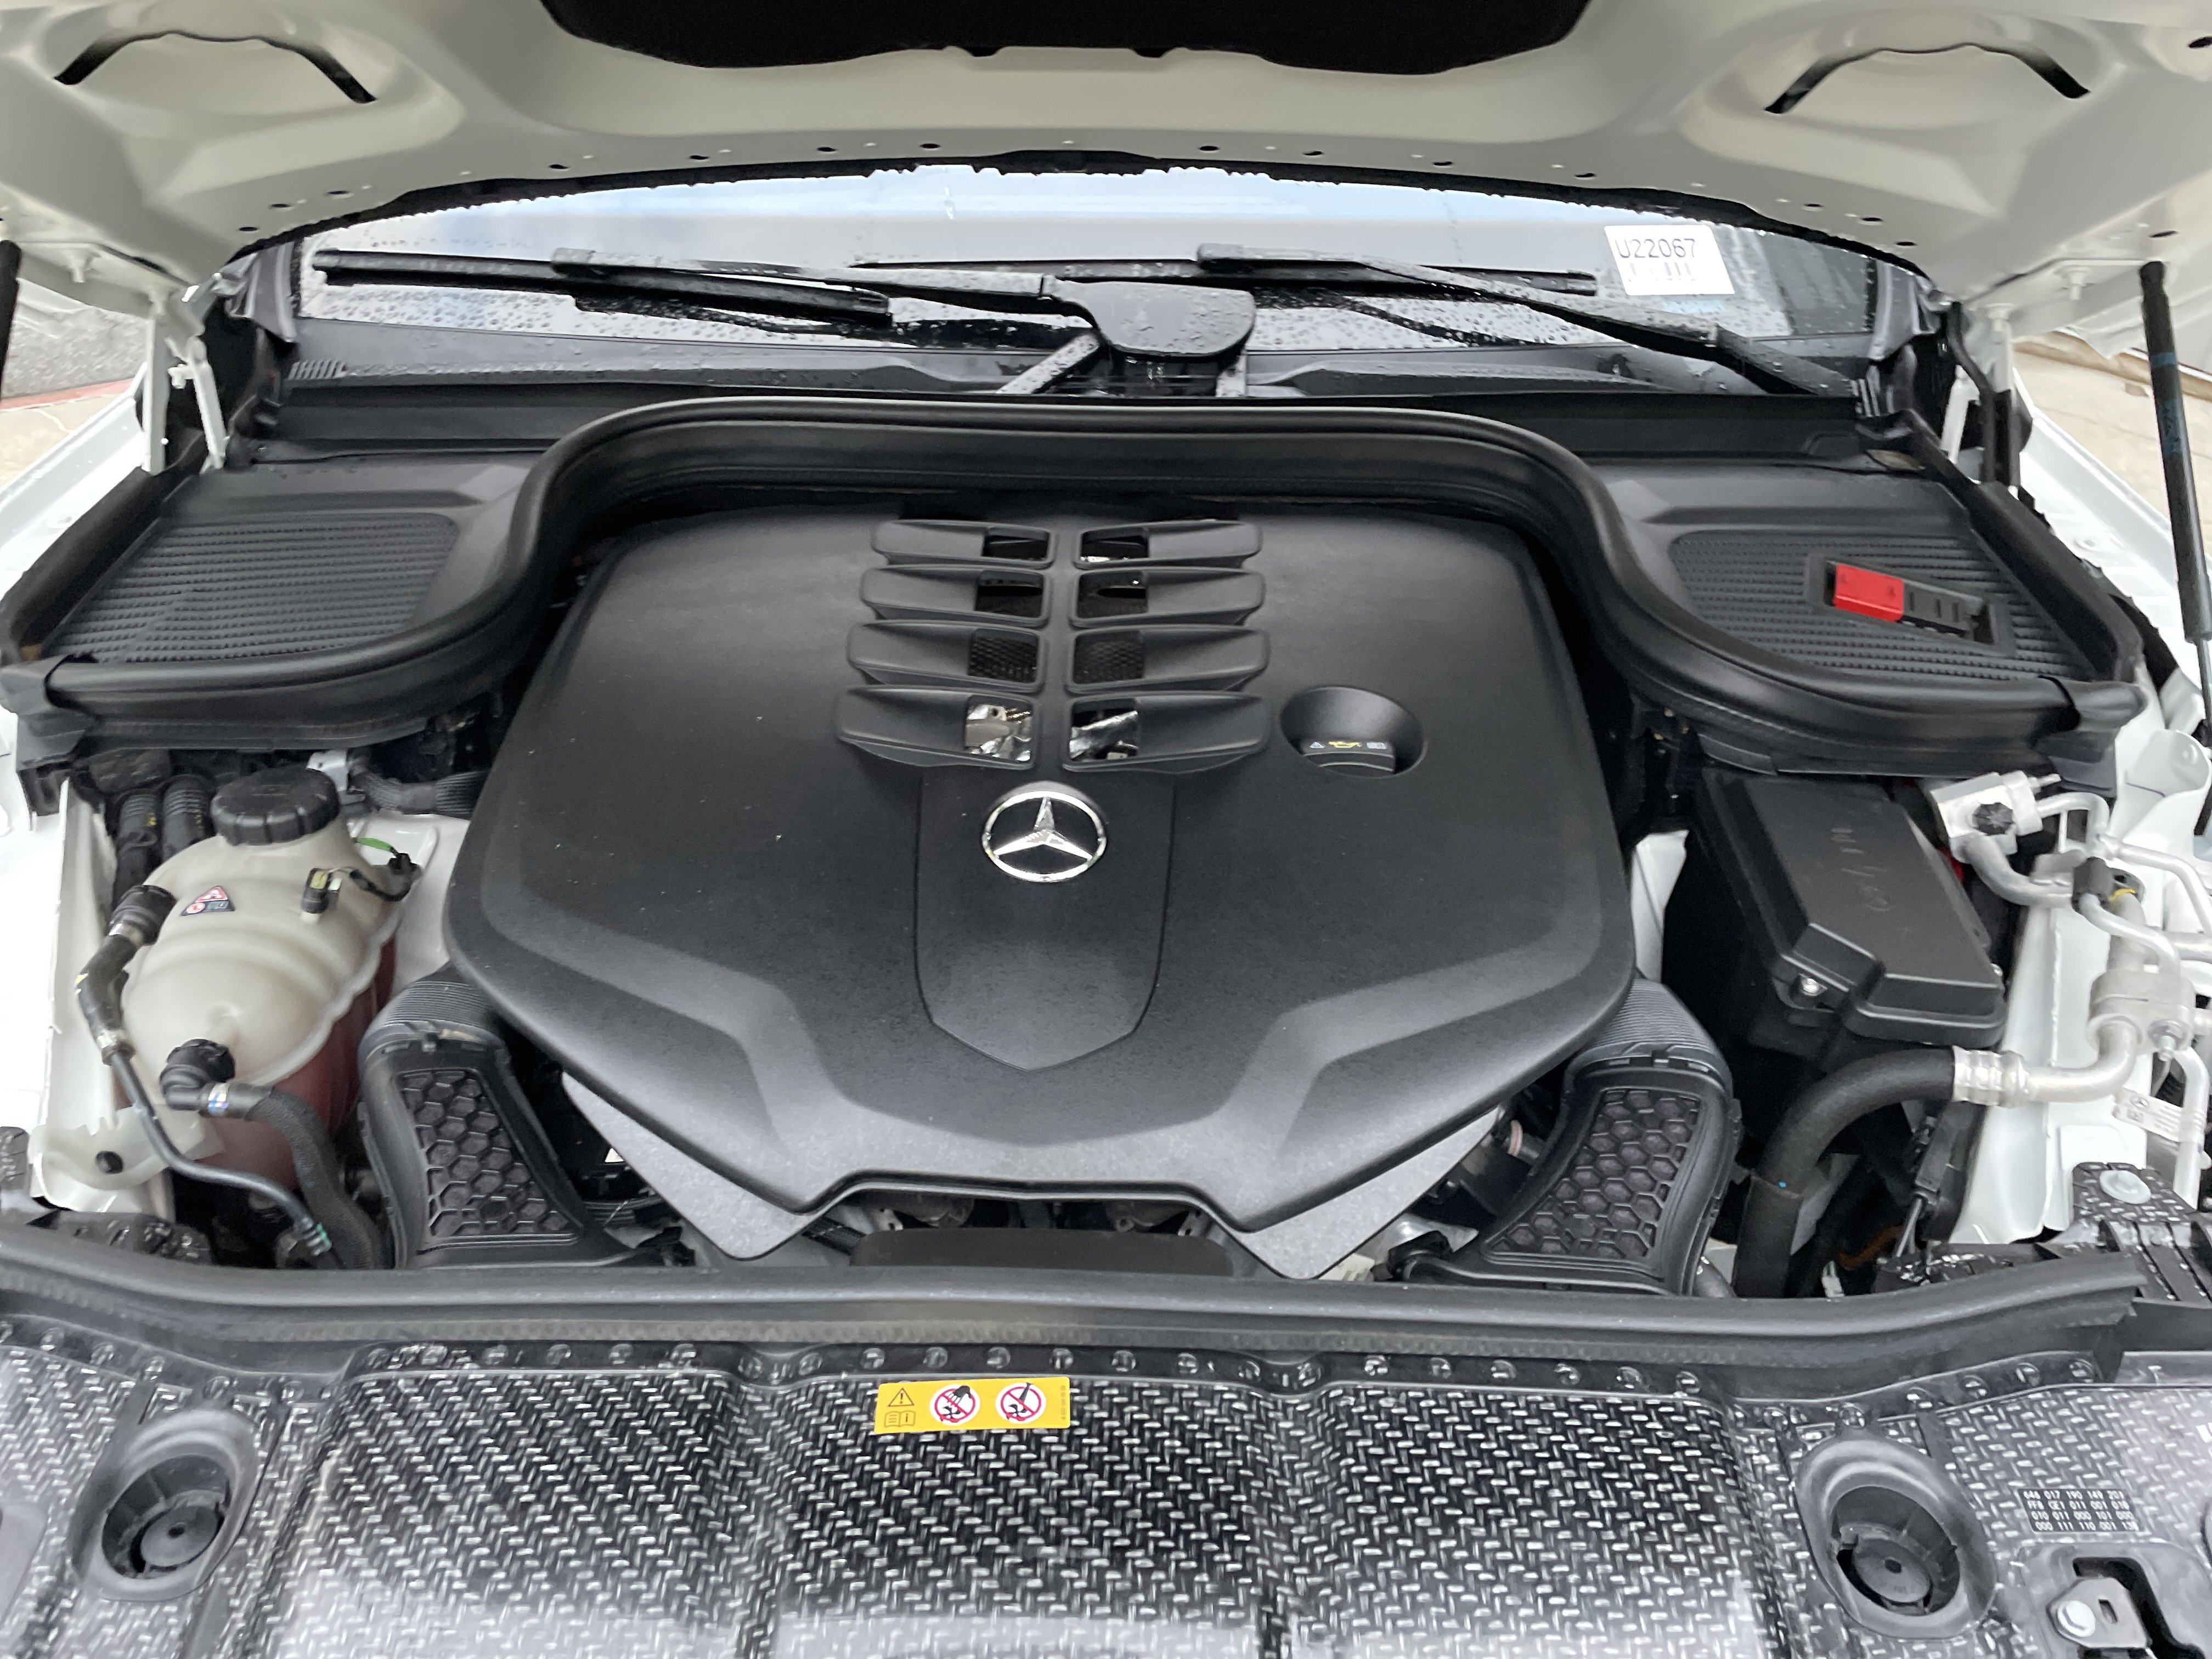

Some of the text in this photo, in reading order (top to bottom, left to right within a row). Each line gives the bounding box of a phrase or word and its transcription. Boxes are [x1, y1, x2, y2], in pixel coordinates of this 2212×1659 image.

[1615, 238, 1696, 258] U22067
[2044, 1490, 2060, 1499] 017
[2069, 1500, 2086, 1510] 011
[2090, 1500, 2108, 1510] 001
[2052, 1511, 2069, 1520] 011
[2096, 1511, 2112, 1520] 101
[2057, 1521, 2074, 1531] 111
[2079, 1522, 2096, 1531] 110
[2099, 1521, 2117, 1531] 001
